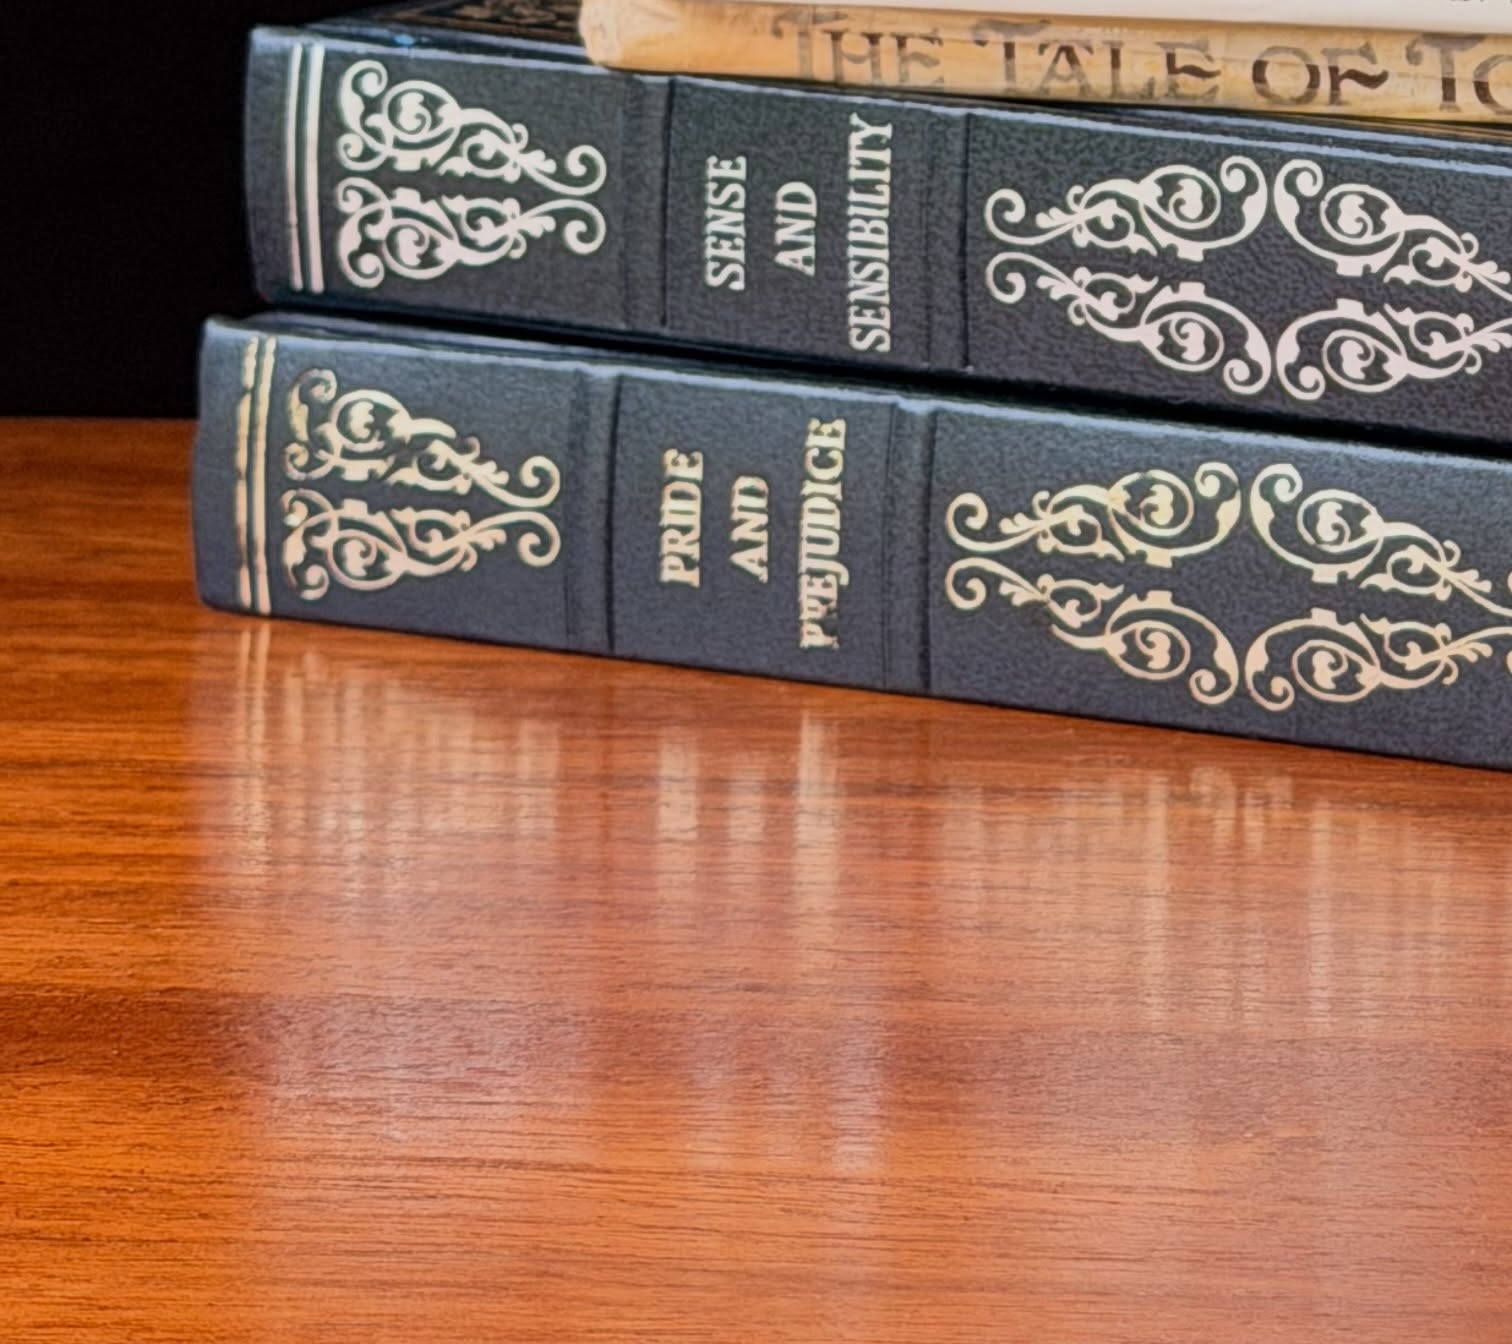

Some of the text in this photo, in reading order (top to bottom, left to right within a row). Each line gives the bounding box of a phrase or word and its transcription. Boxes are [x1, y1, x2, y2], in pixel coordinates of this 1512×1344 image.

[771, 8, 944, 86] THE
[972, 19, 1221, 103] TALE
[1252, 42, 1389, 106] OF
[705, 155, 747, 291] SENSE
[775, 181, 817, 275] AND
[848, 112, 893, 353] SENSIBILITY
[660, 448, 703, 588] PRIDE
[730, 475, 770, 584] AND
[799, 418, 849, 651] PREJUDICE
